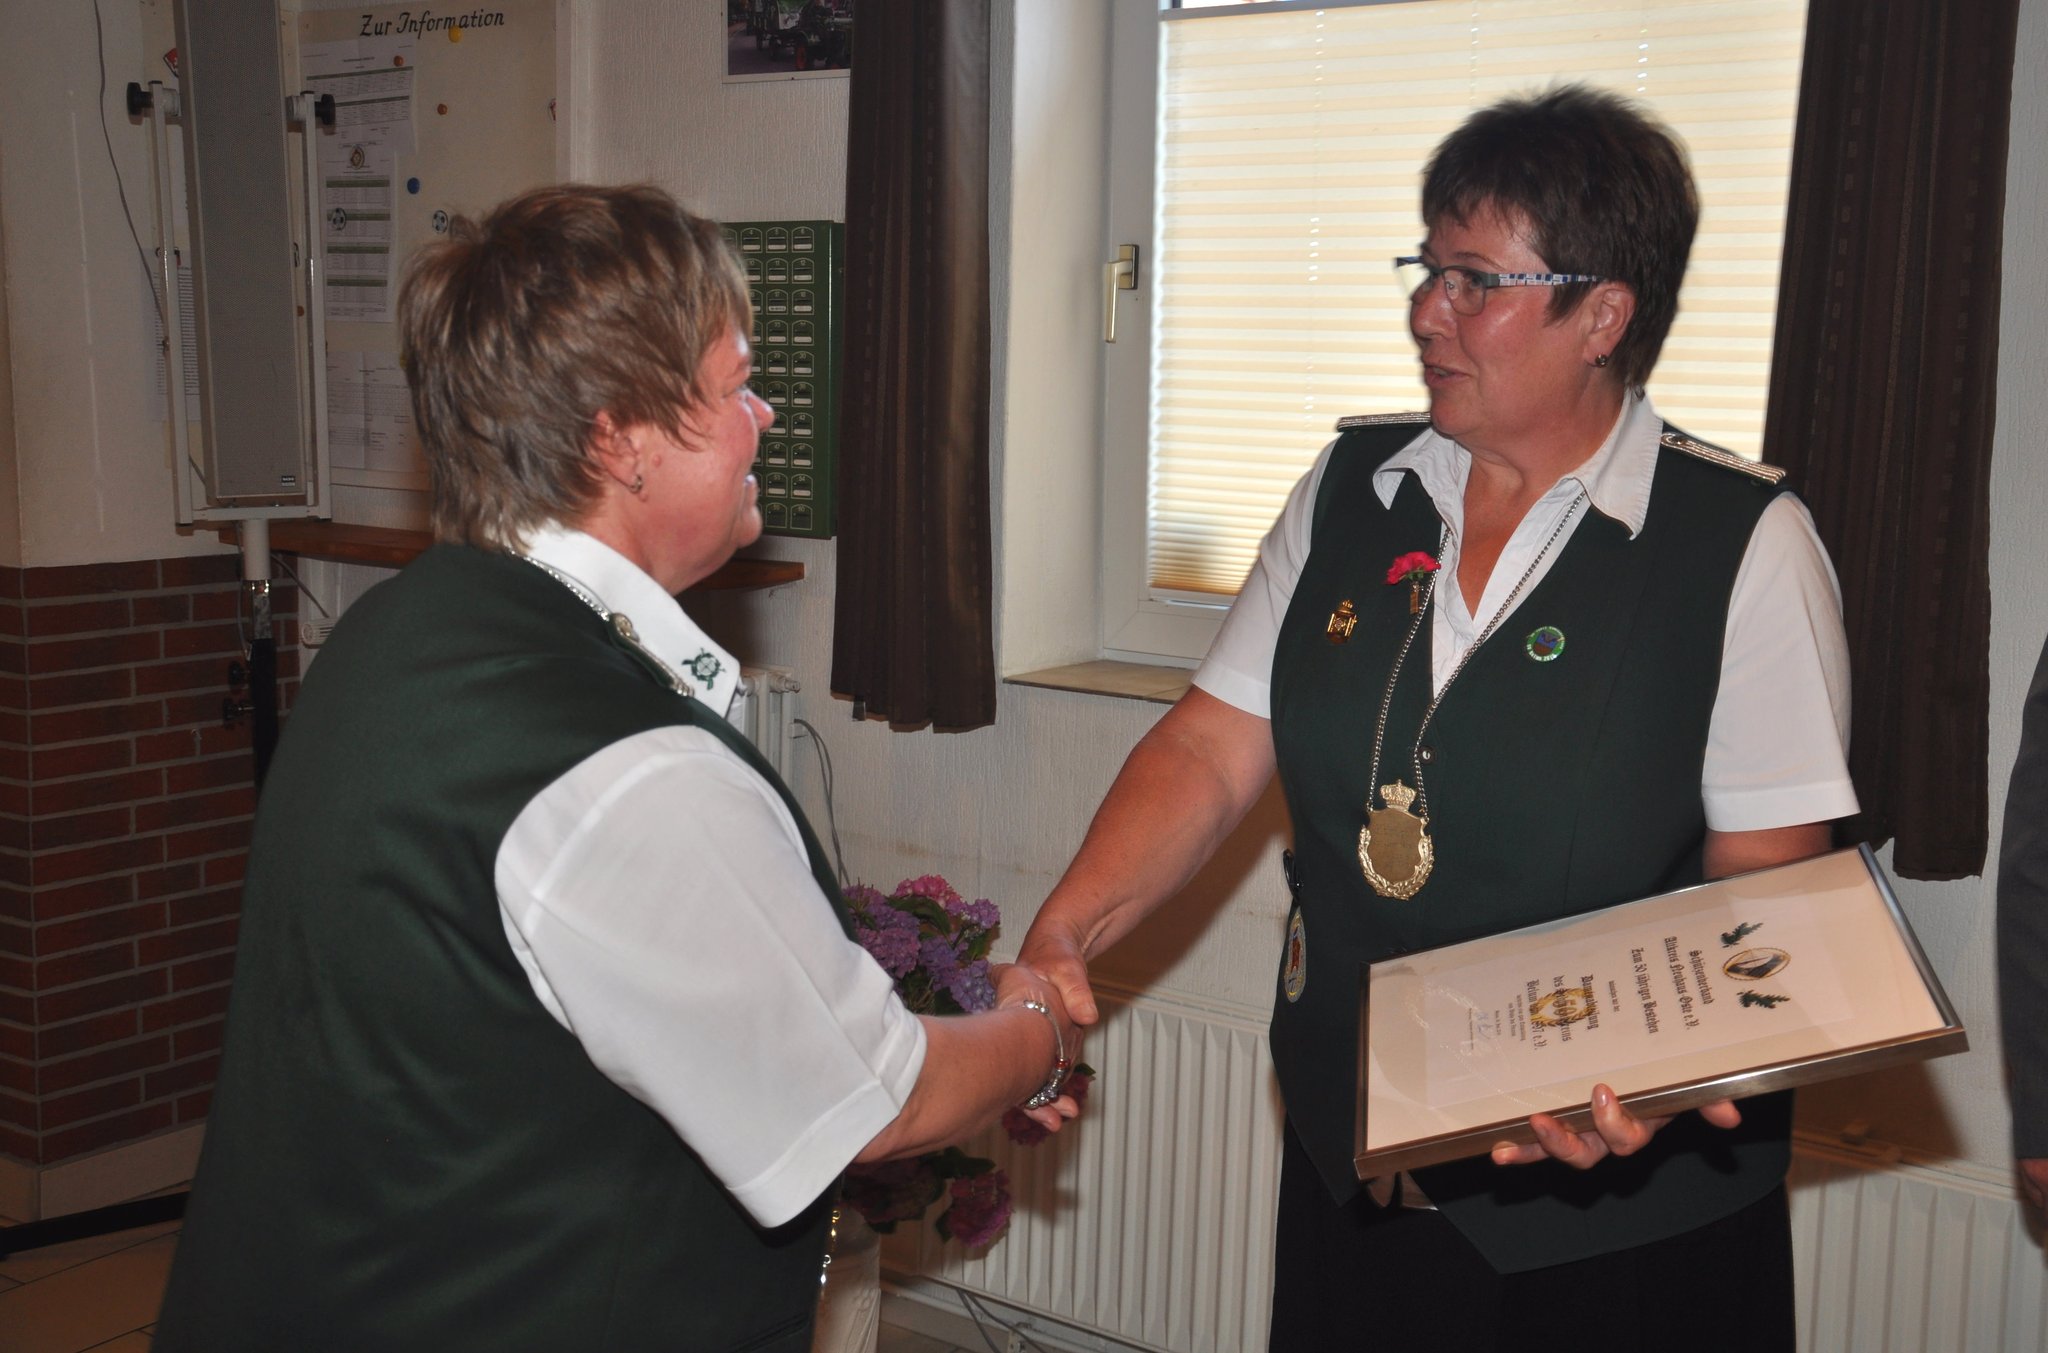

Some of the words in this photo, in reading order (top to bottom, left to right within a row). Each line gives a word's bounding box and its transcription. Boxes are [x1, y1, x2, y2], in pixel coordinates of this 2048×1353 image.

[359, 14, 392, 37] Zur
[396, 9, 505, 39] Information
[1631, 947, 1643, 963] Zum
[1664, 935, 1681, 962] Altkreis
[1635, 963, 1647, 973] 50
[1642, 1000, 1659, 1033] Bestehen
